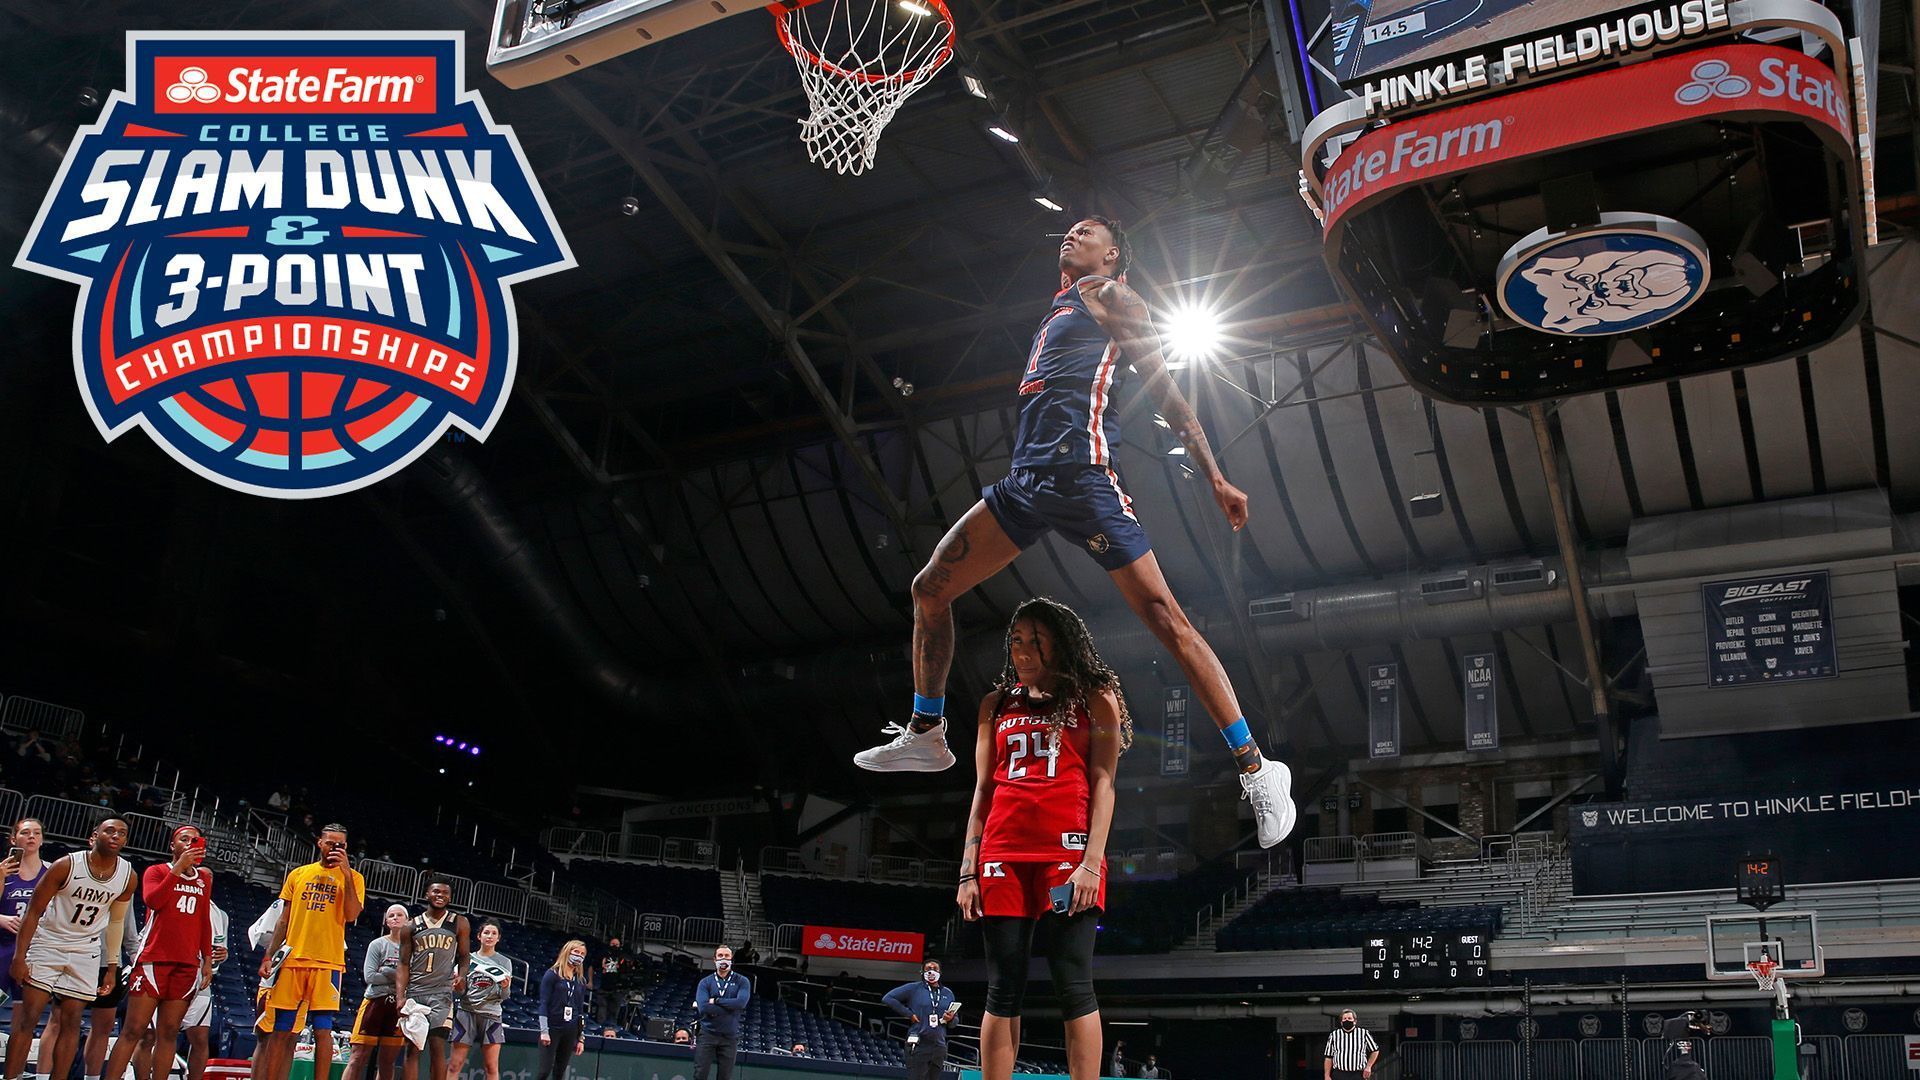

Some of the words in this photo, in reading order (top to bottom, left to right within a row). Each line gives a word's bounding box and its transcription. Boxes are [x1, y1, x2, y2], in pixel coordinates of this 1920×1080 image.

[1371, 20, 1407, 40] 14.5
[1363, 54, 1486, 116] HINKLE
[1502, 0, 1729, 80] FIELDHOUSE
[1726, 616, 1744, 625] BUTLER
[1758, 613, 1776, 622] UCONN
[1791, 609, 1819, 619] CREIGHTON
[1751, 624, 1786, 635] GEORGETOWN
[1792, 621, 1822, 631] MARQUETTE
[1715, 640, 1746, 650] PROVIDENCE
[1755, 638, 1771, 647] SETON
[1772, 637, 1784, 646] HALL
[1720, 652, 1747, 662] VILLANOVA
[1794, 646, 1814, 655] XAVIER
[1468, 668, 1491, 683] NCAA
[1166, 699, 1186, 713] WNIT
[998, 715, 1078, 734] RUTGES
[1007, 731, 1058, 780] 24
[671, 801, 751, 815] CONCESSIONS
[1607, 803, 1714, 826] WELCOME
[1719, 801, 1749, 818] TO
[1755, 795, 1836, 816] HINKLE
[217, 849, 239, 863] 206
[71, 886, 115, 904] ARMY
[173, 884, 204, 896] LABAMA
[305, 882, 337, 894] THREE
[176, 896, 197, 914] 40
[301, 892, 336, 904] STRIPE
[306, 901, 326, 912] LIFE
[70, 904, 100, 926] 13
[579, 916, 593, 927] 207
[643, 921, 661, 932] 208
[415, 934, 454, 952] LIONS
[1370, 939, 1384, 947] HOME
[1461, 935, 1479, 944] GUEST
[1378, 948, 1386, 961] 0
[1421, 953, 1427, 963] 0
[1473, 945, 1481, 958] 0
[425, 952, 434, 973] 1
[1374, 969, 1380, 979] 0
[1393, 969, 1400, 979] 0
[1450, 967, 1457, 977] 0
[1477, 967, 1483, 977] 0
